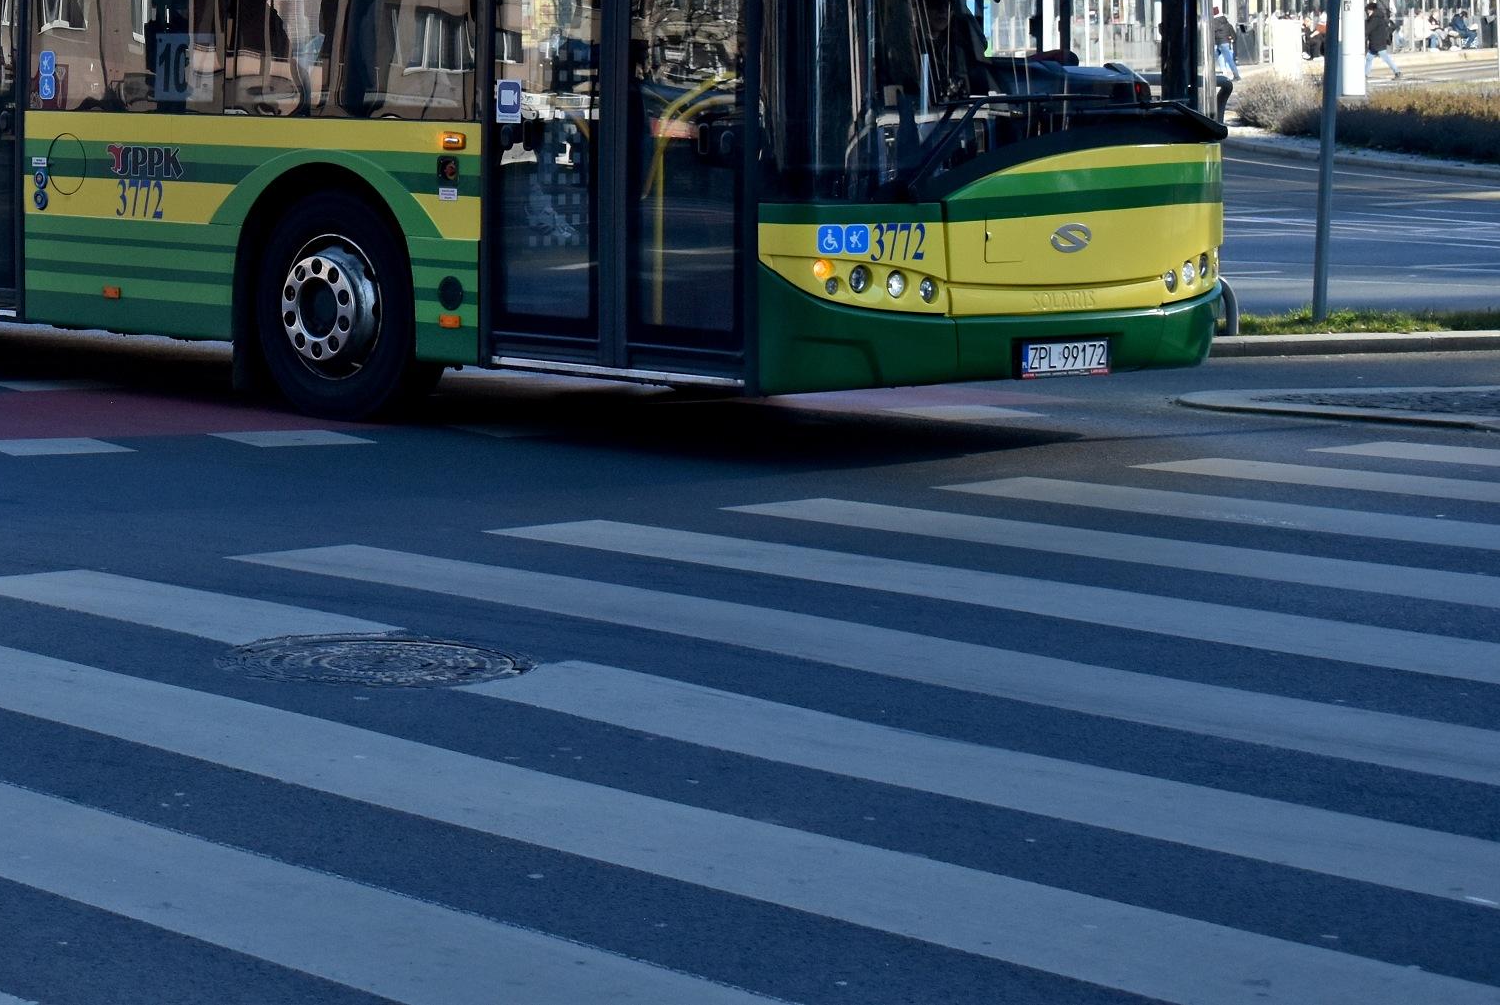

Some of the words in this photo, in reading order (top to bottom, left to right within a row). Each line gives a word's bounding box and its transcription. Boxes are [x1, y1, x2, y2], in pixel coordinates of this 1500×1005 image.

[115, 178, 164, 219] 3772
[870, 222, 926, 262] 3772
[1031, 290, 1097, 311] SOLARIS
[1029, 345, 1057, 371] ZPL
[1062, 342, 1106, 369] 99172
